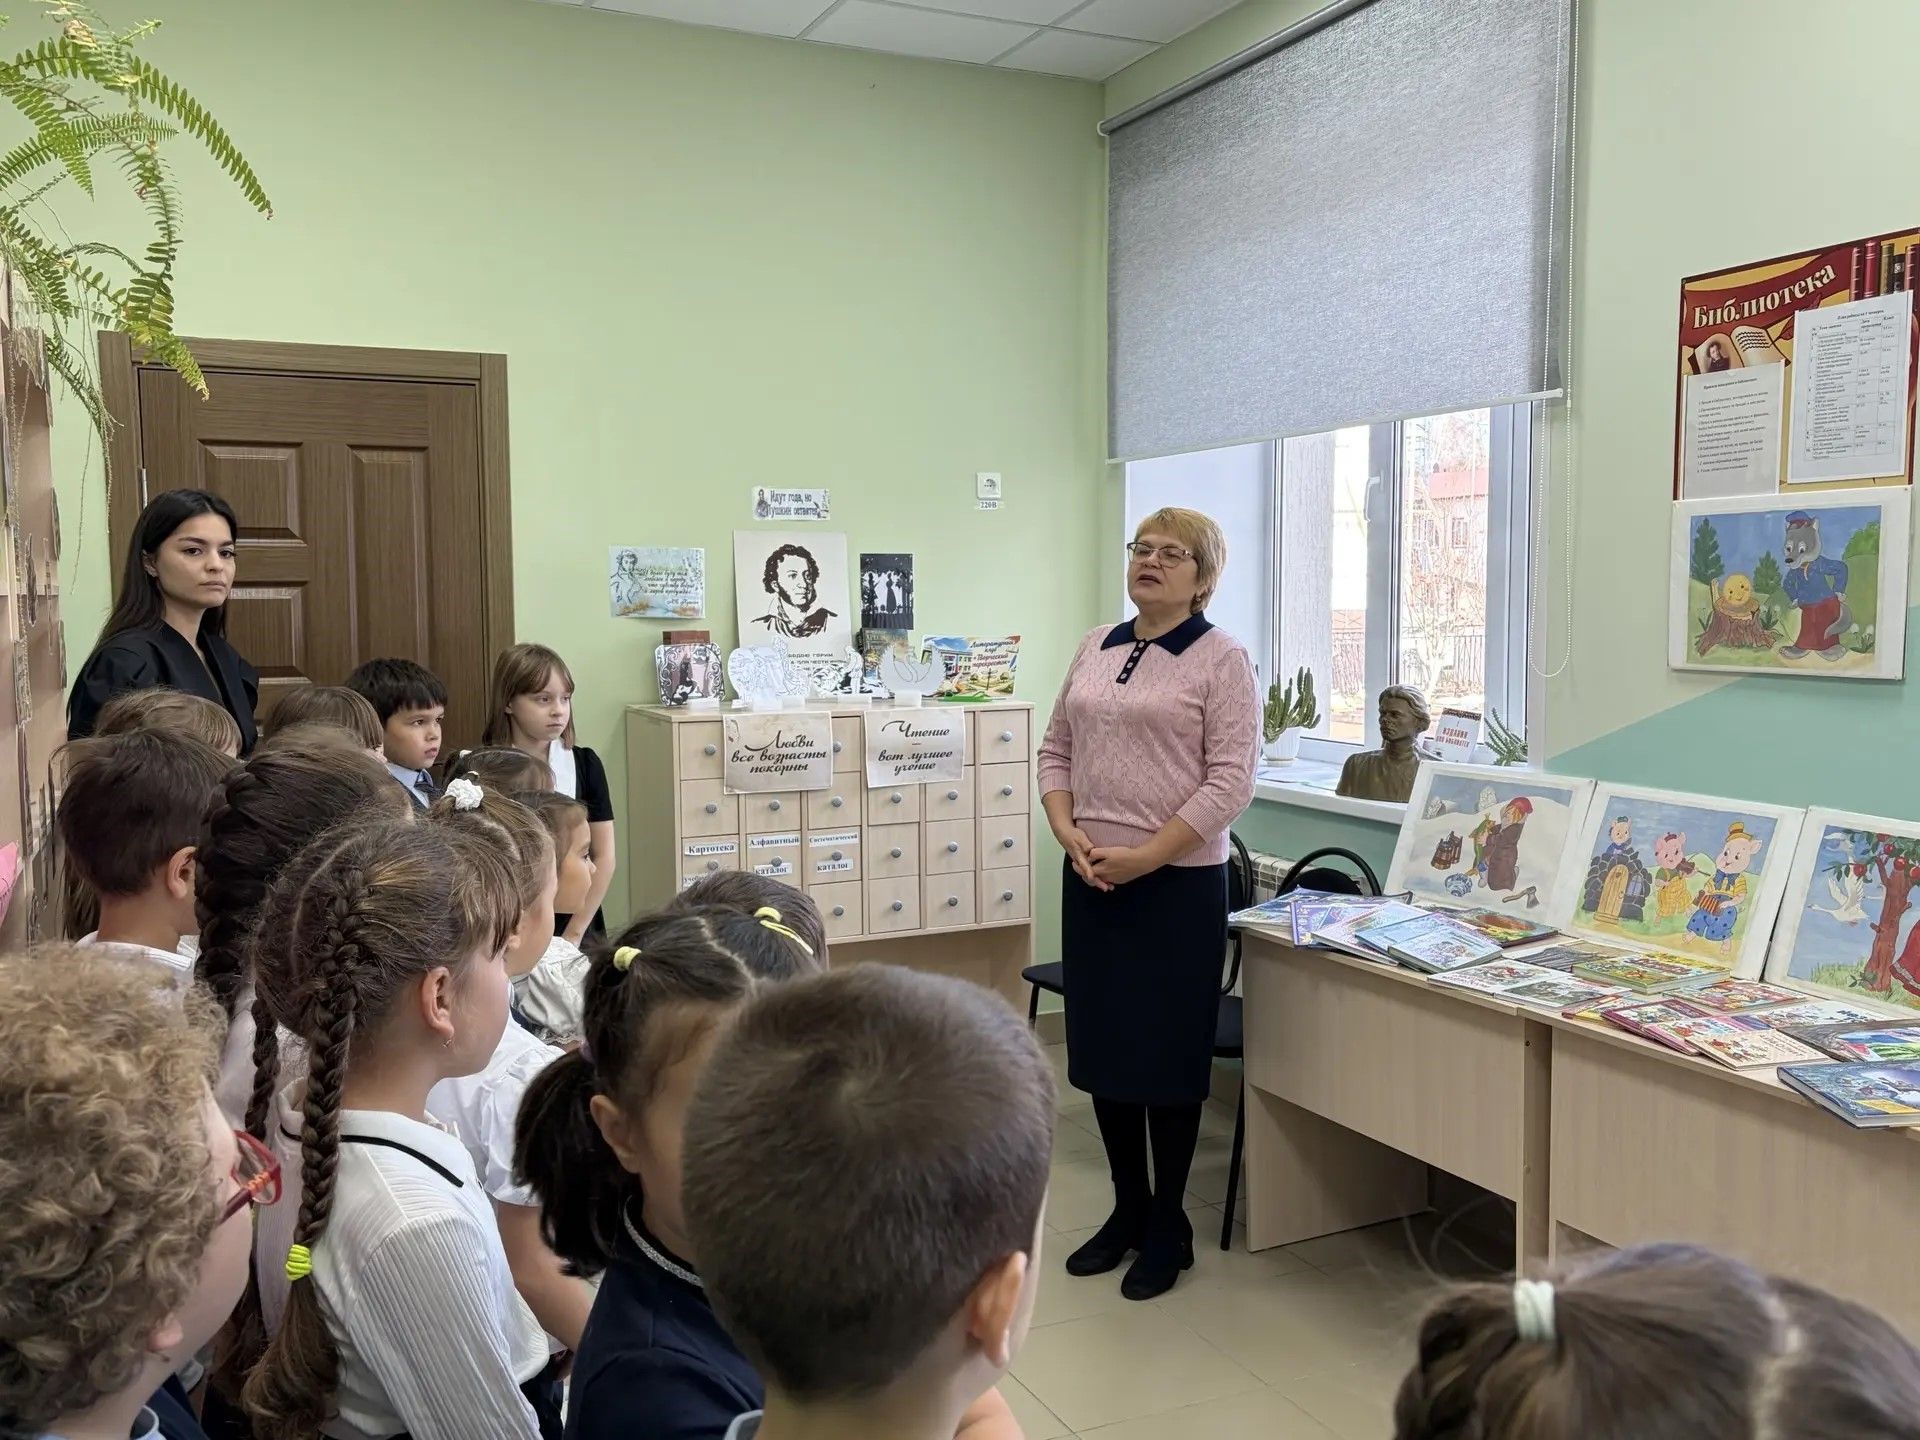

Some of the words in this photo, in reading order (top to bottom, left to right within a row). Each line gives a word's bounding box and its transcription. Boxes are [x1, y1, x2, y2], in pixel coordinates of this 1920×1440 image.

[1693, 264, 1836, 329] Библиотека
[770, 490, 786, 505] Идут
[805, 493, 812, 502] но
[882, 720, 950, 738] Чтение
[744, 730, 814, 752] Любви
[731, 750, 755, 763] все
[760, 749, 827, 765] возрасты
[878, 749, 903, 762] вот
[907, 750, 953, 763] лучшее
[749, 763, 808, 776] покорны
[894, 761, 936, 776] учение
[750, 836, 800, 848] Алфавитный
[688, 844, 735, 856] Картотека
[755, 866, 788, 876] каталог
[817, 863, 849, 872] каталог
